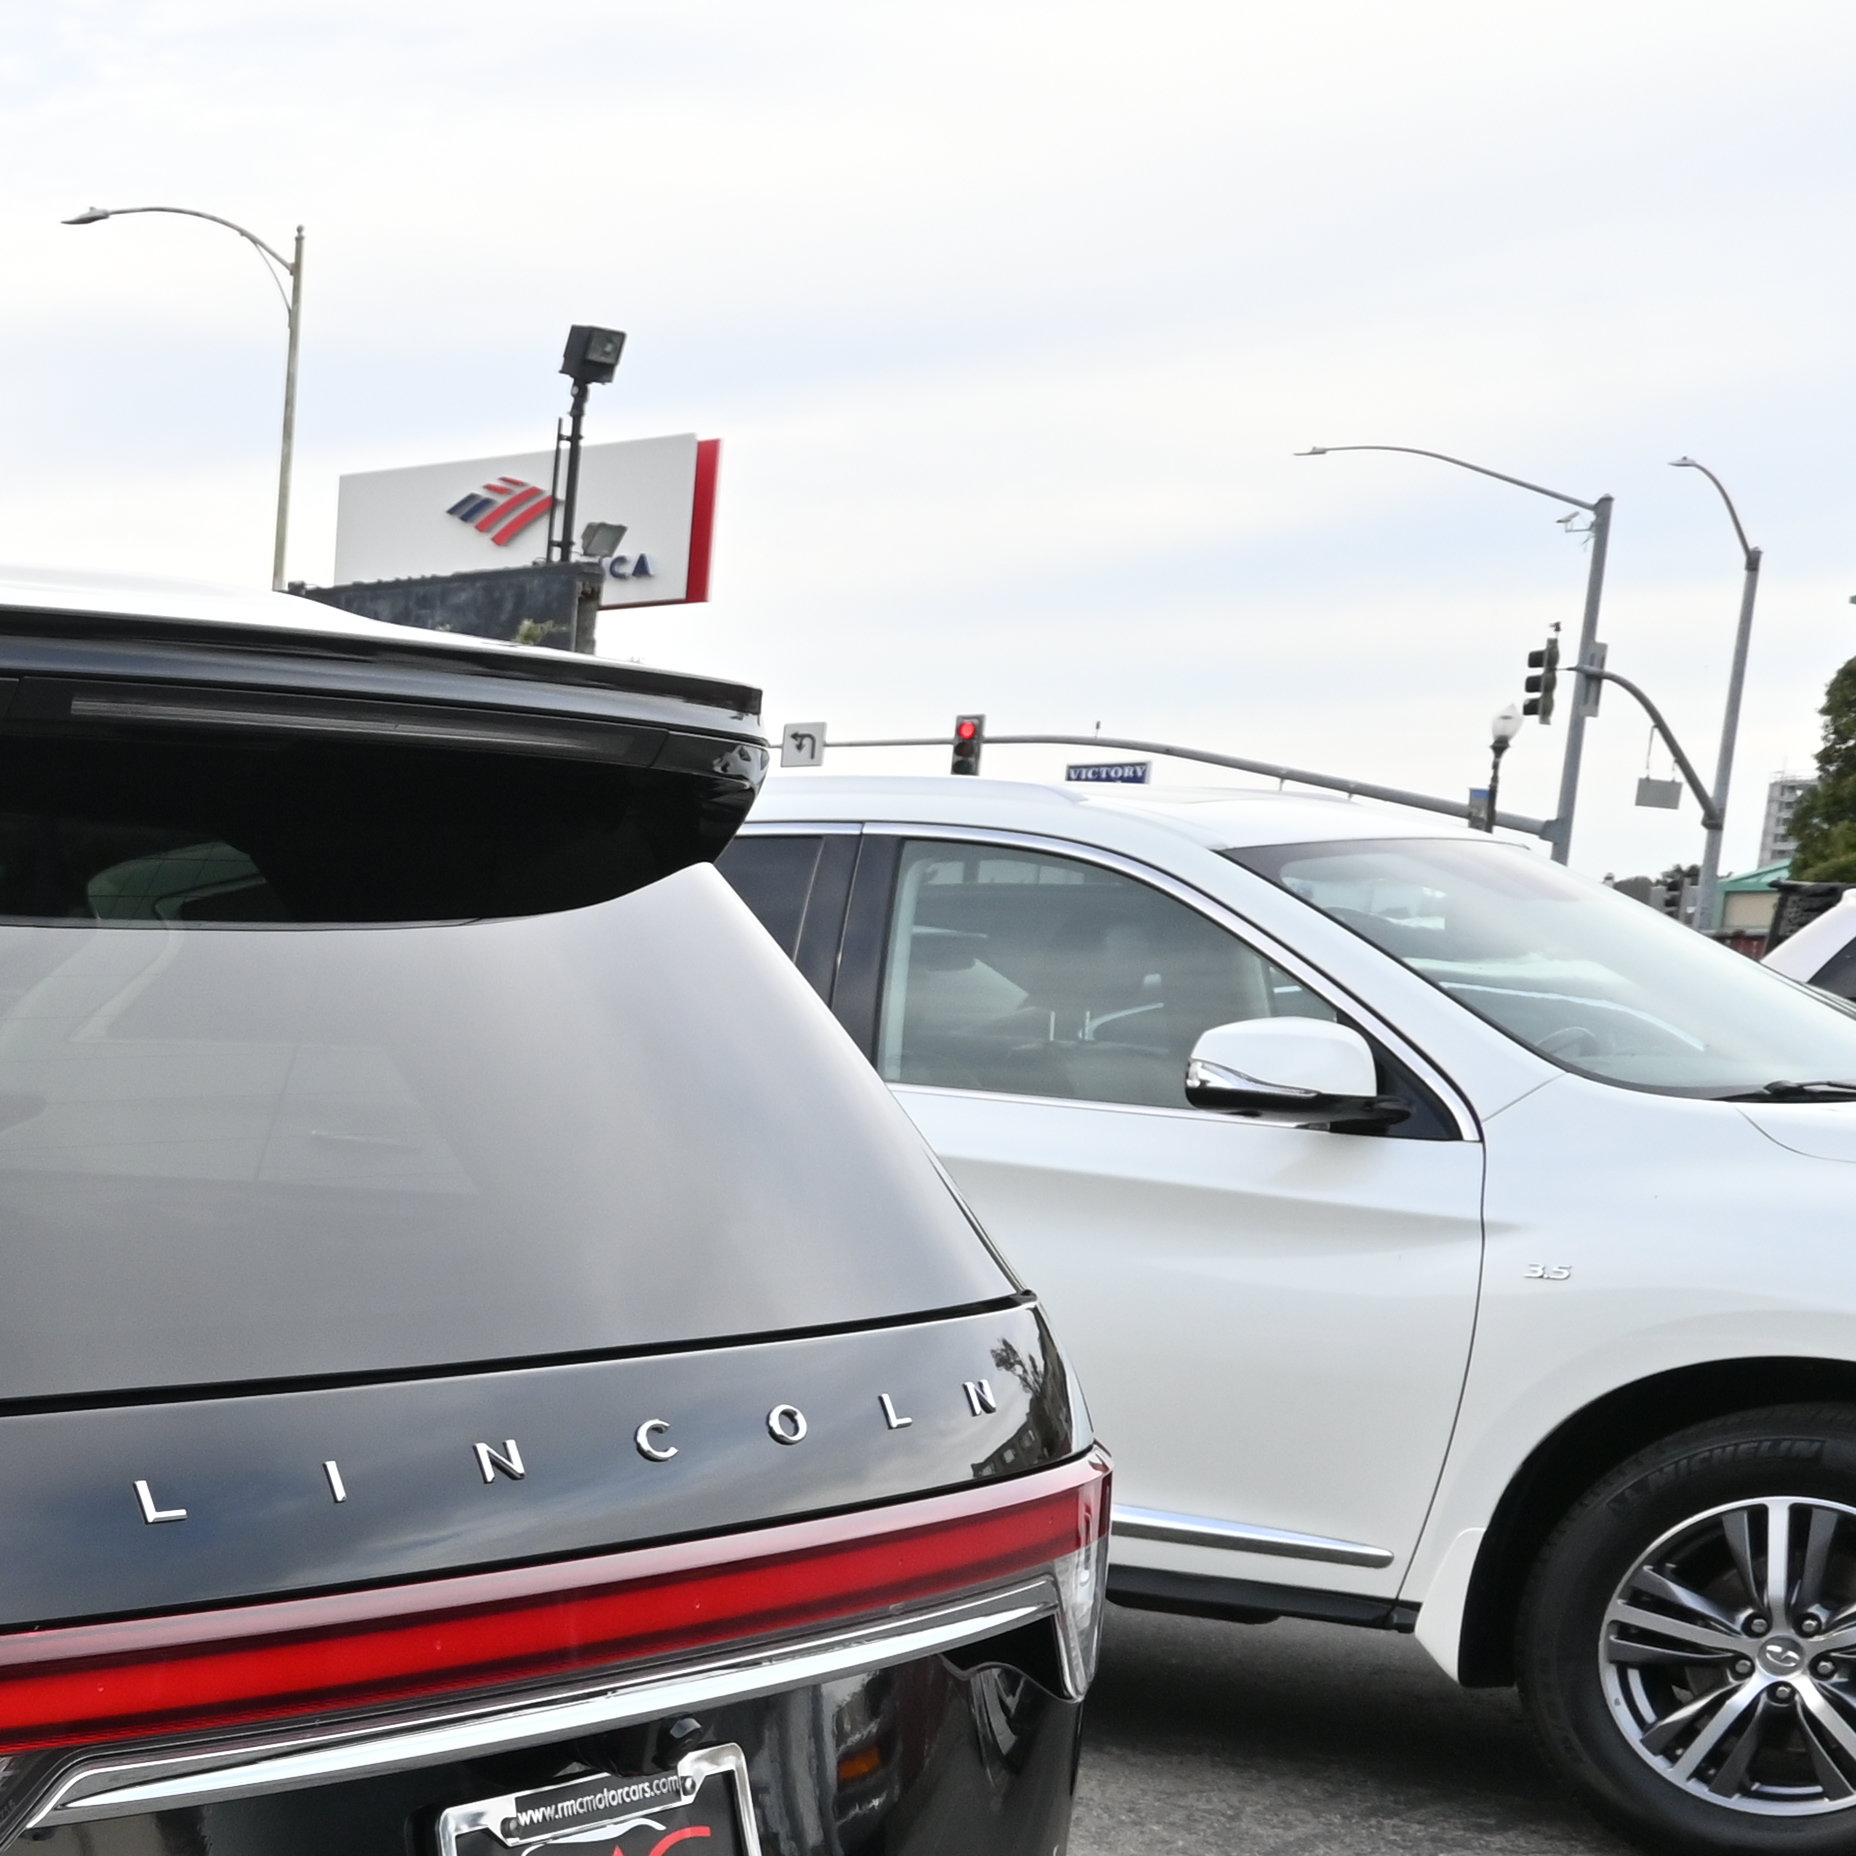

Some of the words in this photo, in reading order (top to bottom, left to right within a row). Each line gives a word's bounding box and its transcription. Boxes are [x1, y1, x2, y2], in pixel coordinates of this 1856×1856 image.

[1069, 765, 1146, 780] VICTORY
[1523, 1262, 1573, 1281] 3.5
[132, 1377, 998, 1526] LINCOLN
[1647, 1439, 1824, 1494] MICHELIN
[517, 1776, 679, 1826] www.rmcmotorcars.com
